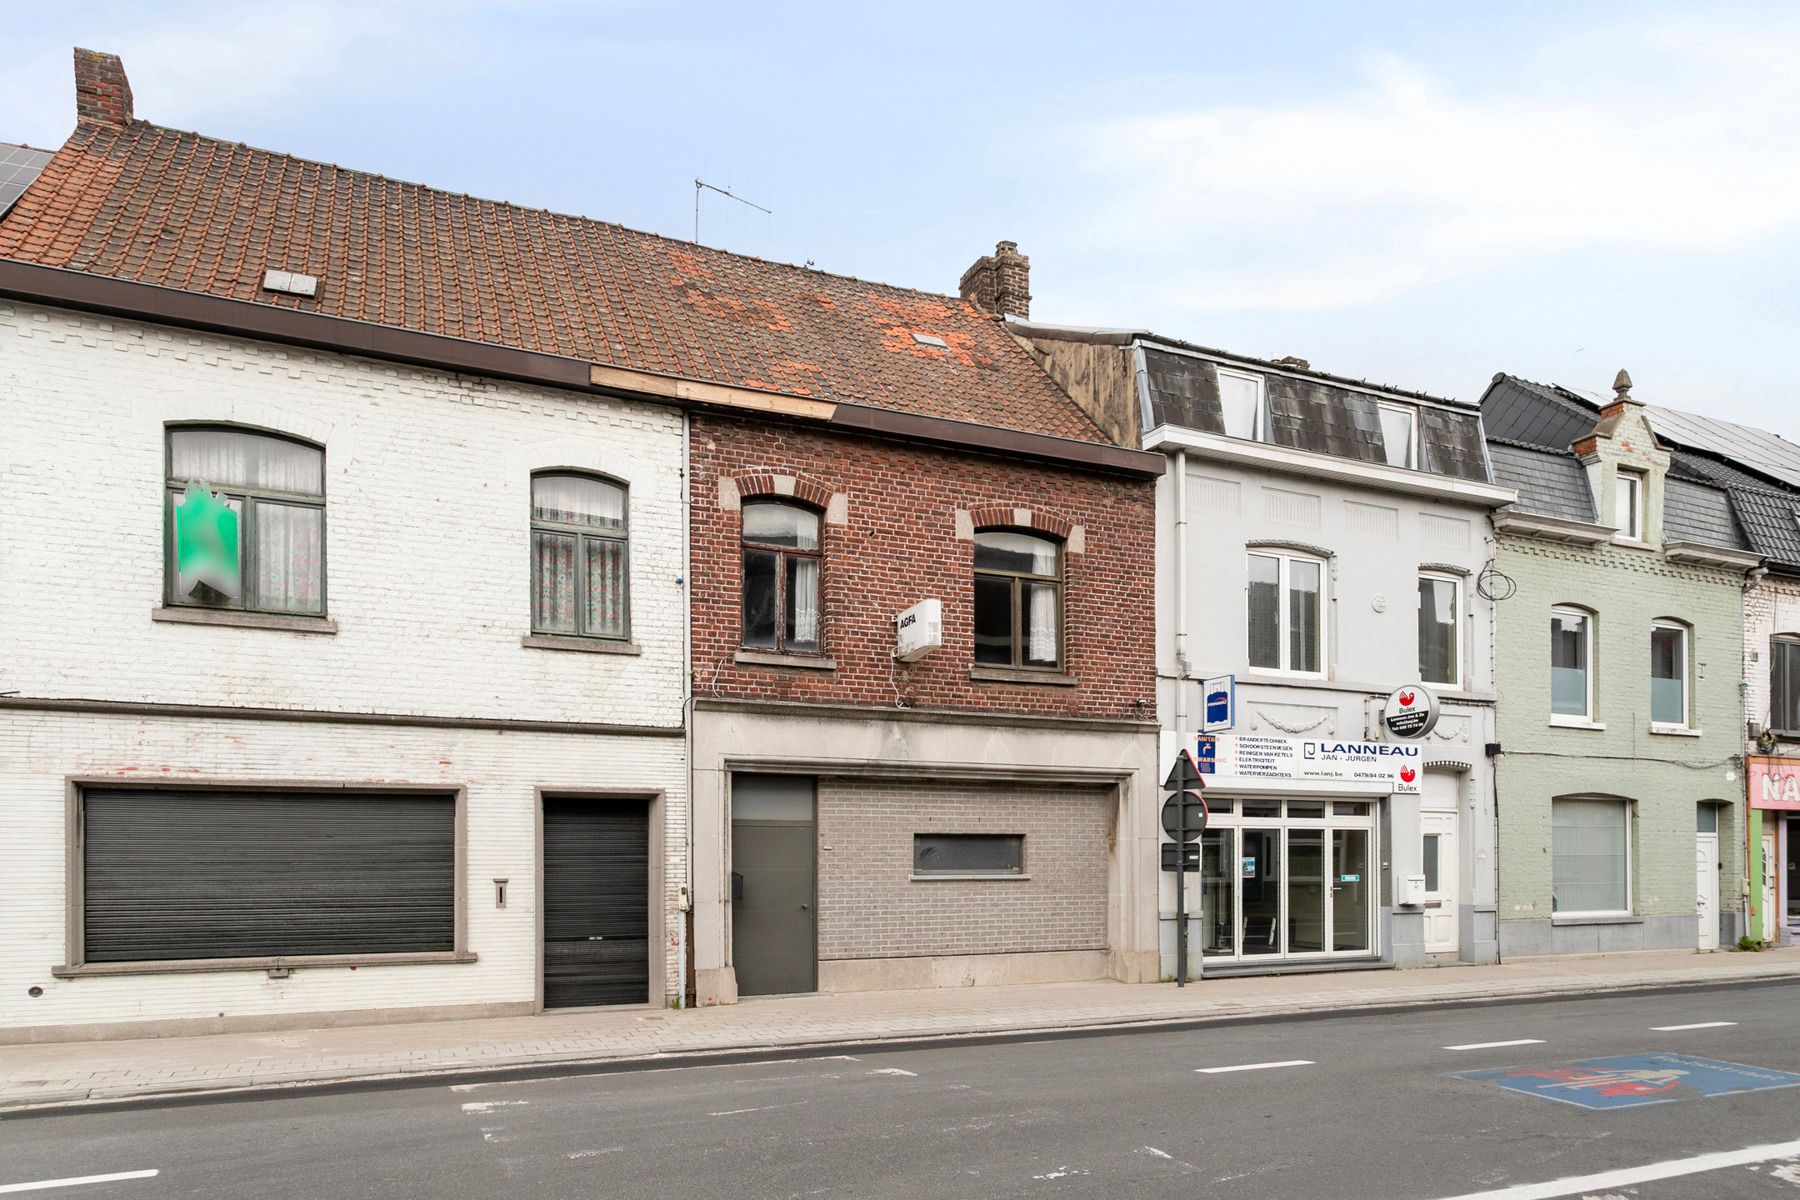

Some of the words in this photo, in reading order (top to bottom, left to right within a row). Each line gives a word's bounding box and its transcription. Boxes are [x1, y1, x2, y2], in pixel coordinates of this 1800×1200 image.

[900, 613, 916, 629] AGFA
[1399, 706, 1415, 714] Bulex
[1321, 743, 1418, 757] LANNEAU
[1345, 755, 1377, 763] JURGEN
[1398, 784, 1417, 792] Bulex
